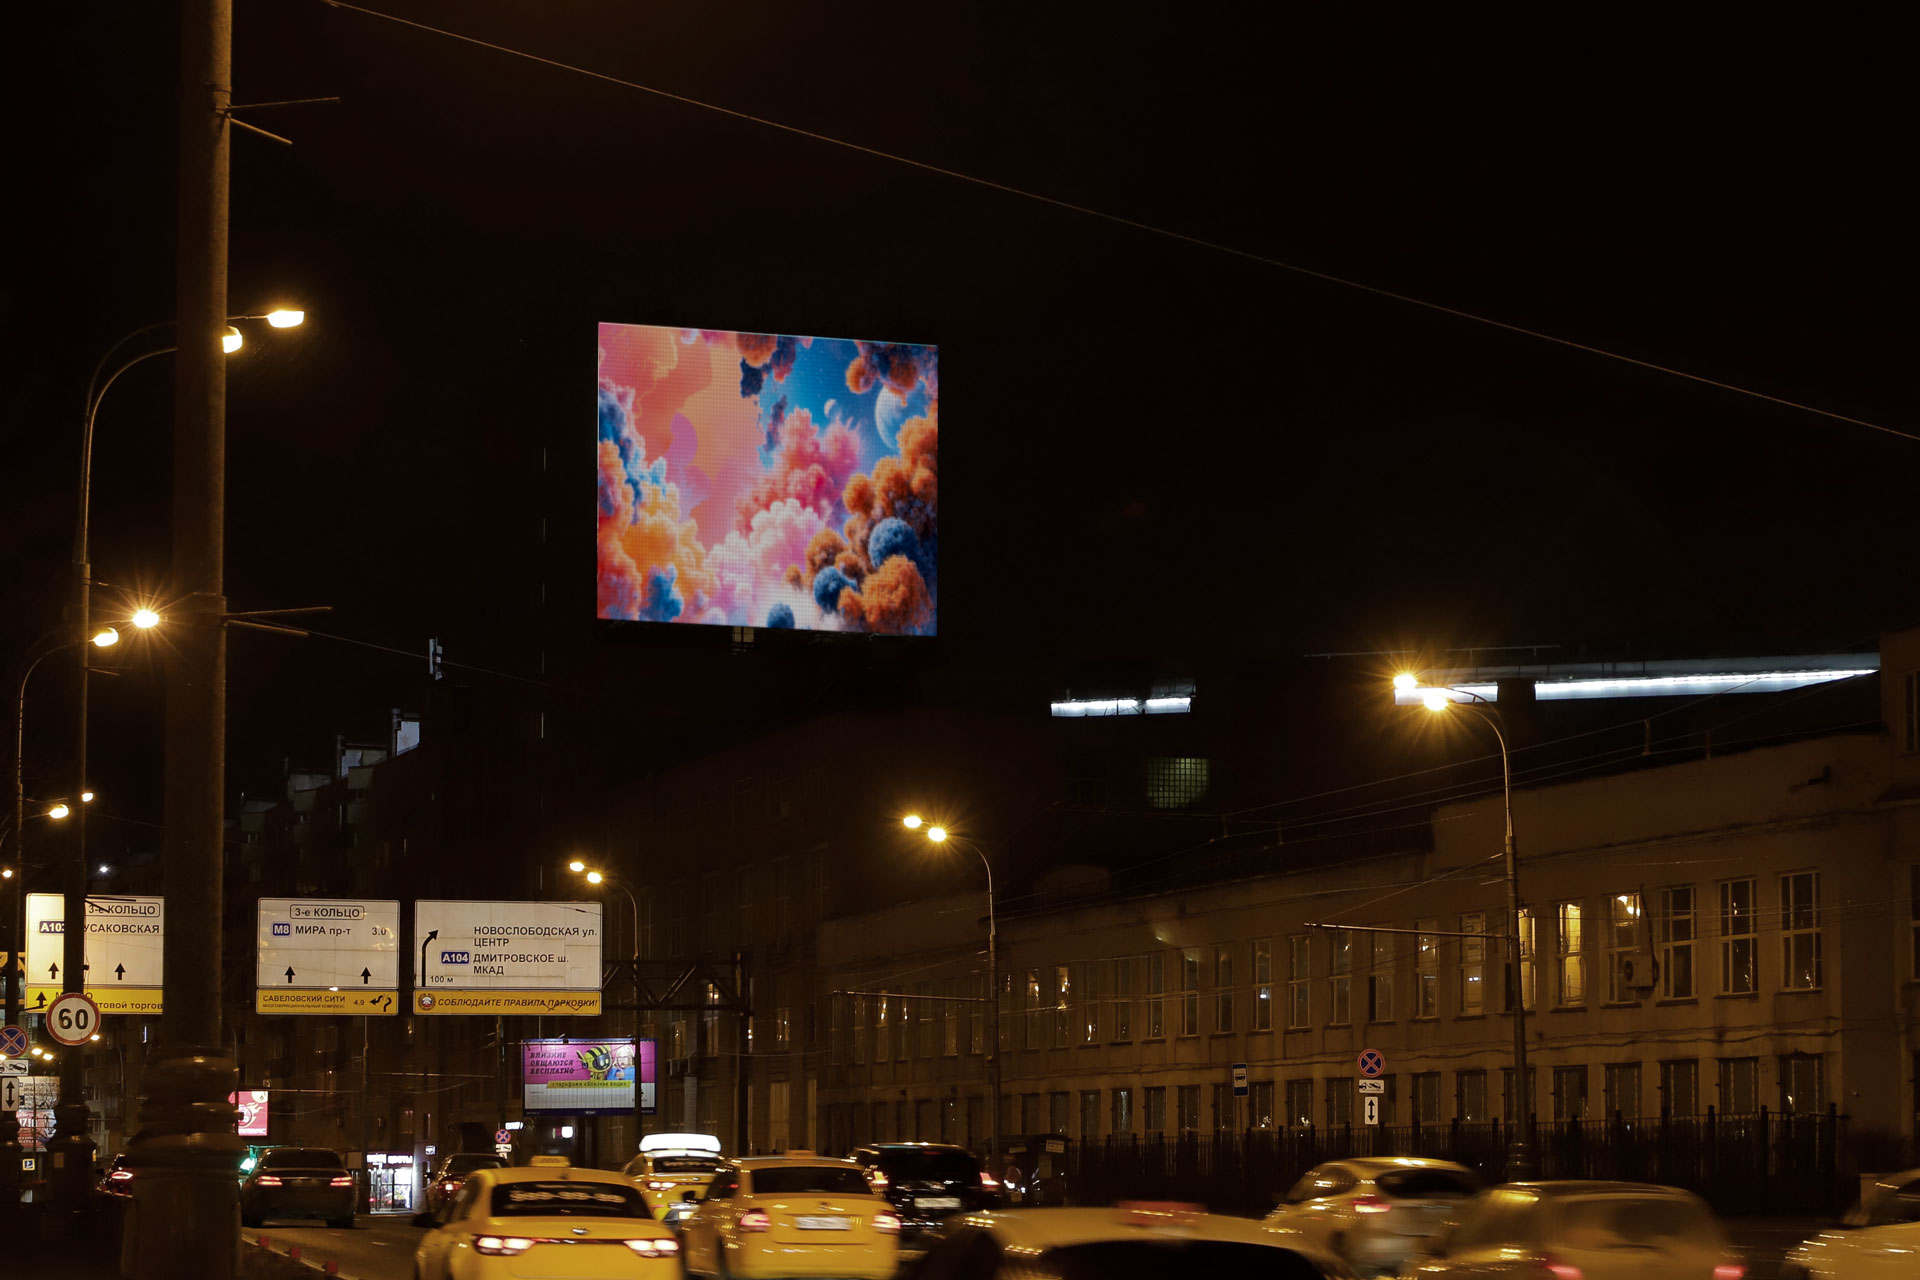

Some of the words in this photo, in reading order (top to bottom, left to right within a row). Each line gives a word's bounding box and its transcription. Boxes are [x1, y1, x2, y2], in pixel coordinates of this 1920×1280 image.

[108, 905, 156, 916] КОЛЬЦО
[294, 908, 311, 917] 3-е
[313, 908, 360, 918] КОЛЬЦО
[84, 924, 160, 933] УСАКОВСКАЯ
[274, 924, 290, 934] М8
[295, 926, 326, 935] МИРА
[329, 927, 351, 937] пр-т
[371, 927, 387, 936] 3.0
[474, 927, 580, 937] НОВОСЛОБОДСКАЯ
[582, 929, 598, 938] ул.
[474, 938, 510, 948] ЦЕНТР
[441, 953, 469, 963] А104
[473, 953, 555, 964] ДМИТРОВСКОЕ
[557, 955, 569, 963] ш.
[473, 965, 504, 976] МКАД
[324, 995, 346, 1003] СИТИ
[437, 998, 502, 1007] СОБЛЮДАЙТЕ
[503, 998, 546, 1007] ПРАВИЛА
[547, 999, 598, 1008] ПАРКОВКИ!
[58, 1008, 89, 1030] 60
